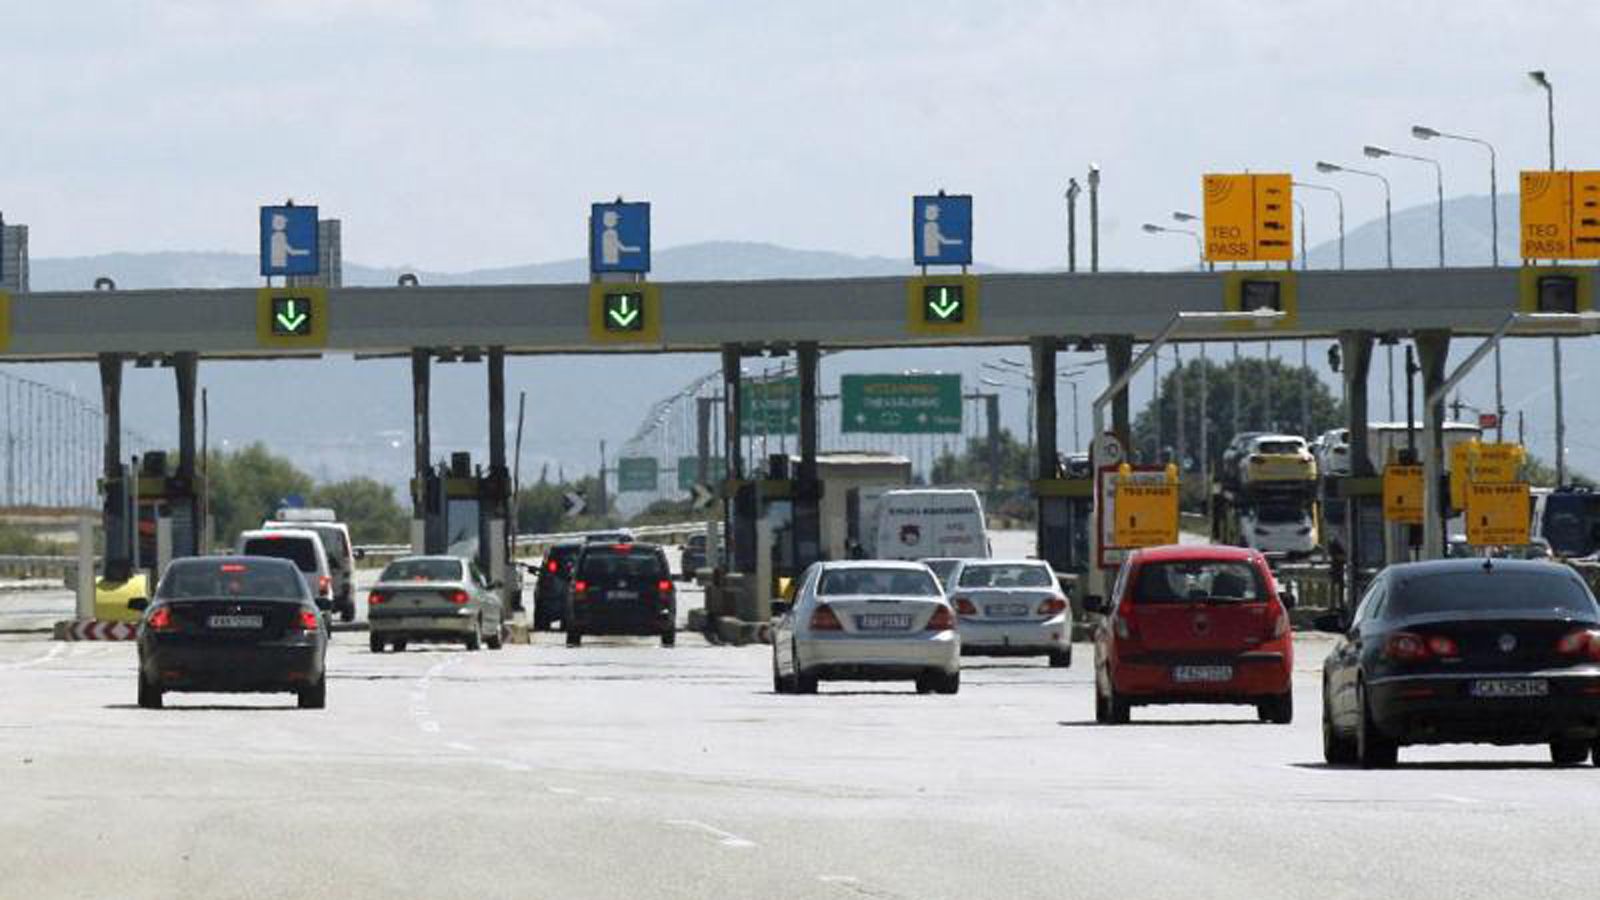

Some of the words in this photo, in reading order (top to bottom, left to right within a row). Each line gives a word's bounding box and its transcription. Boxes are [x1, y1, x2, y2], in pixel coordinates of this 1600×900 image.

[1211, 226, 1241, 239] TEO
[1528, 224, 1559, 237] TEO
[1208, 242, 1249, 256] PASS
[1525, 240, 1566, 254] PASS
